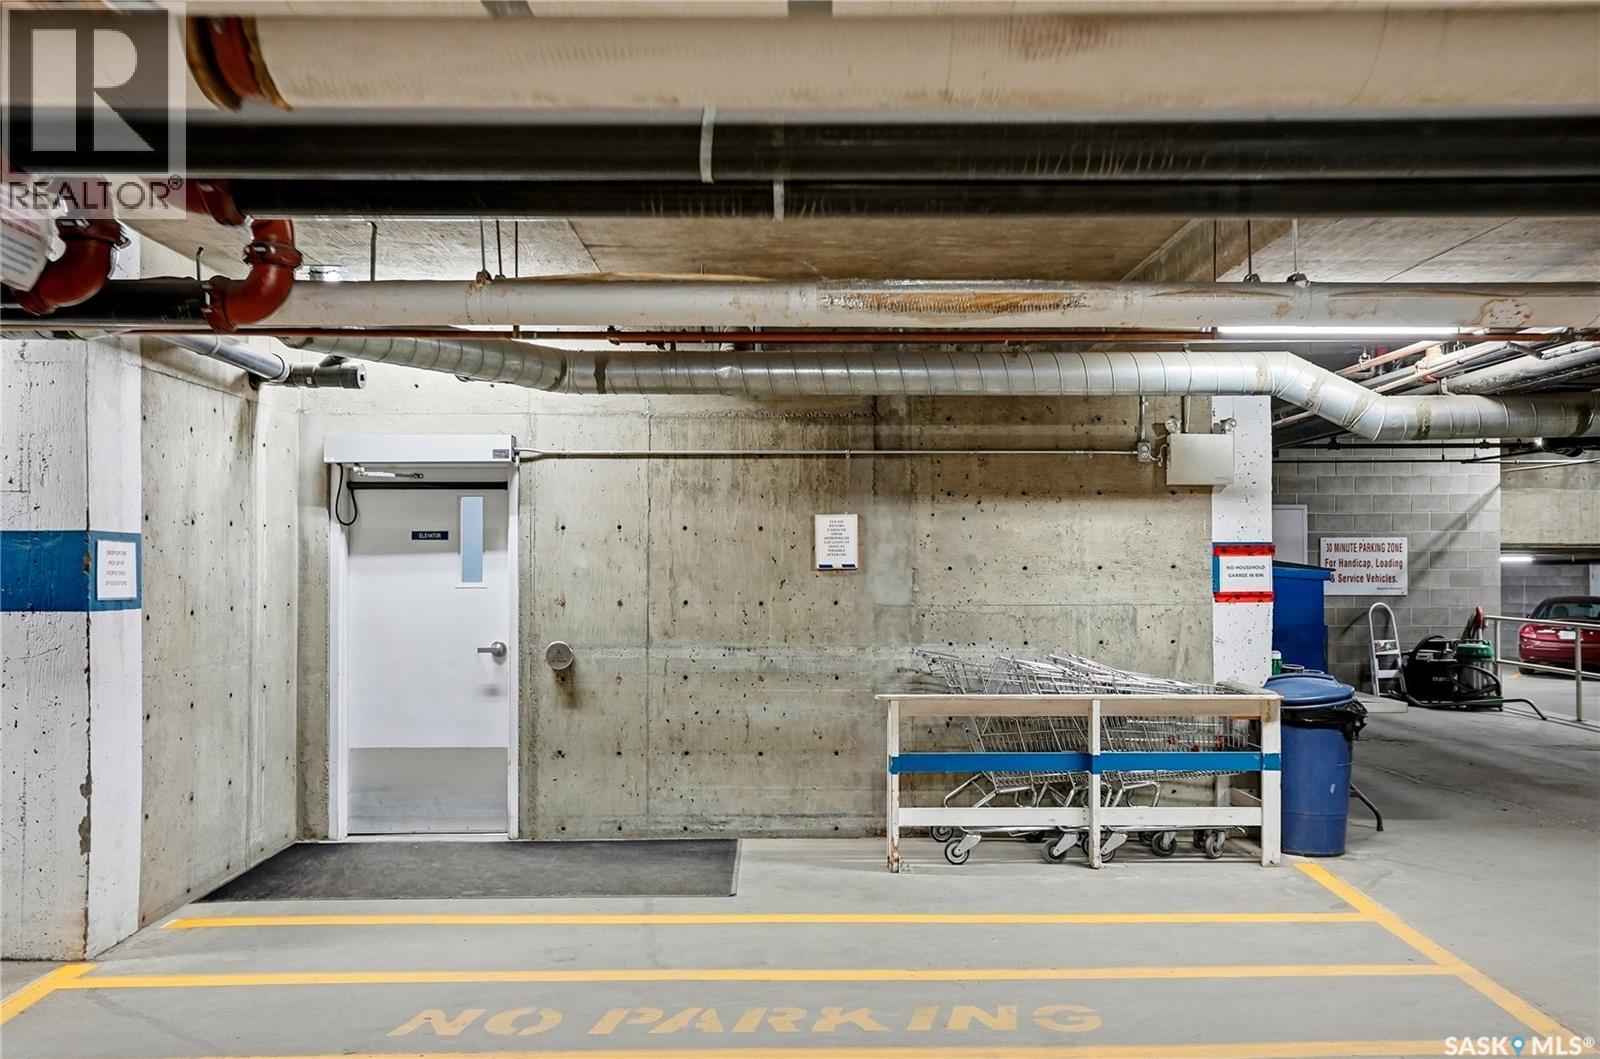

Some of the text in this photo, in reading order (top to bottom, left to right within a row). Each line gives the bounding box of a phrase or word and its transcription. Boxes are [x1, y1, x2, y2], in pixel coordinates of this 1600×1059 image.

[1326, 543, 1402, 552] 30 MINUTE PARKING ZONE
[1324, 558, 1403, 569] For Handicap, Loading
[1330, 573, 1398, 583] & Service Vehicles.
[386, 1004, 1103, 1036] NO PARKING
